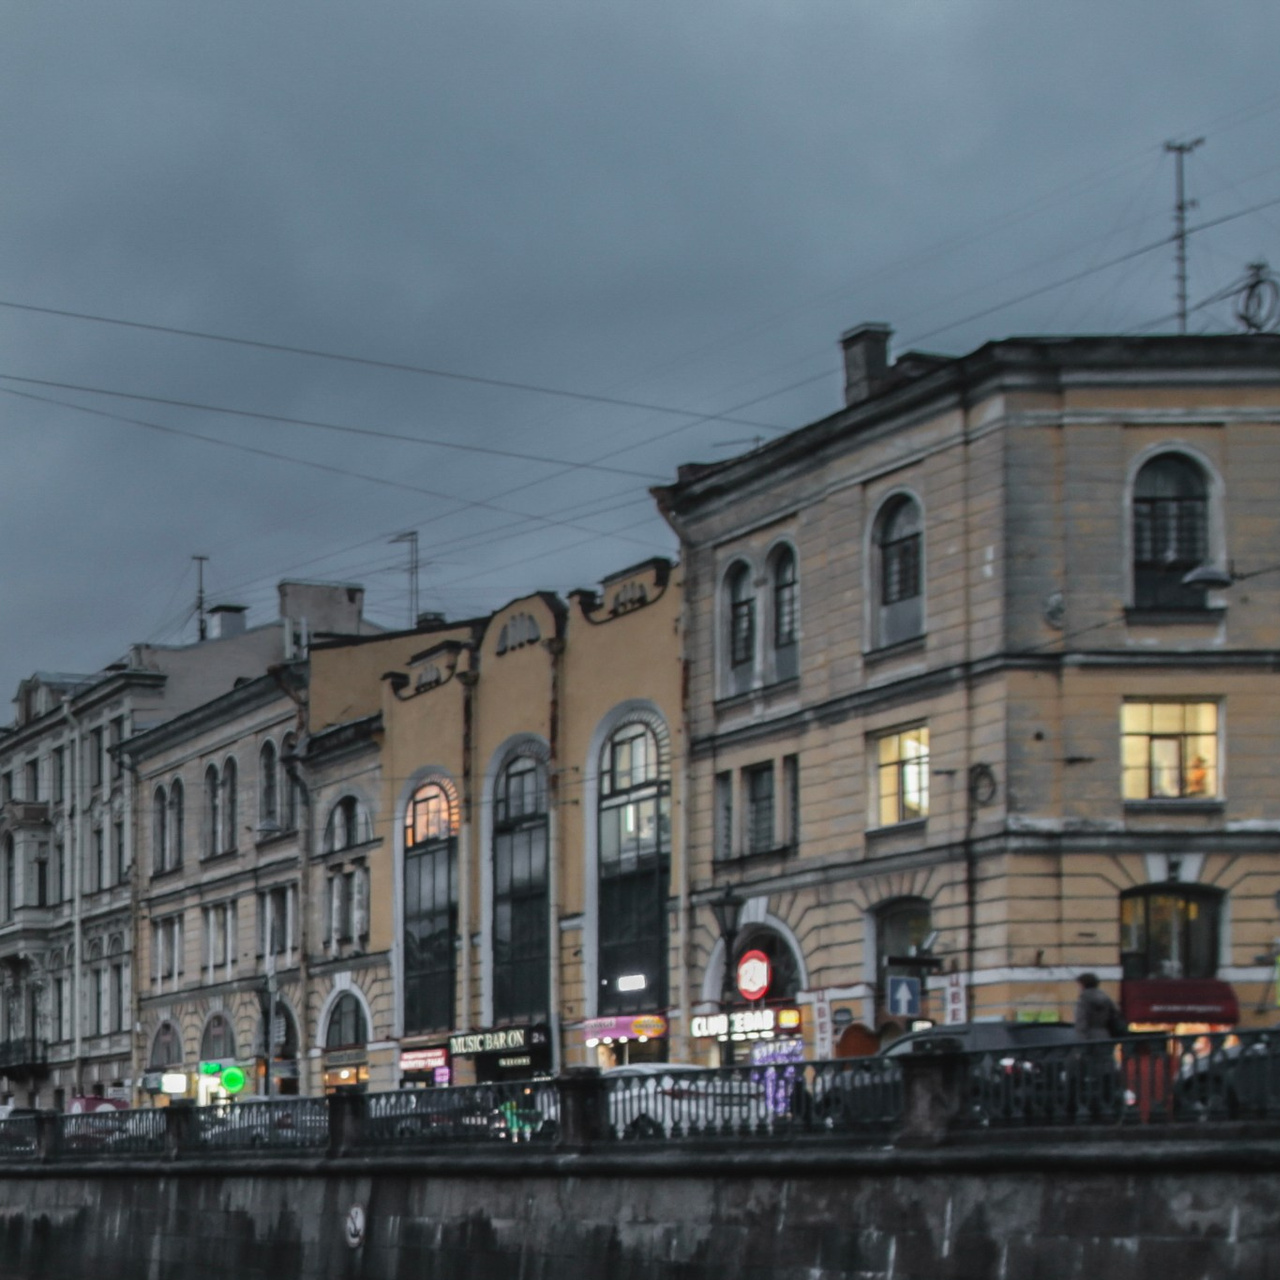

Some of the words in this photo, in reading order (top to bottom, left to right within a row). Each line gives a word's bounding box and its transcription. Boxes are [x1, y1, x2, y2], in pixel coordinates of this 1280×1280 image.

[949, 974, 962, 1022] ЦВЕ
[450, 1034, 484, 1054] MUSIC
[484, 1031, 506, 1050] BAR
[507, 1029, 524, 1047] ON
